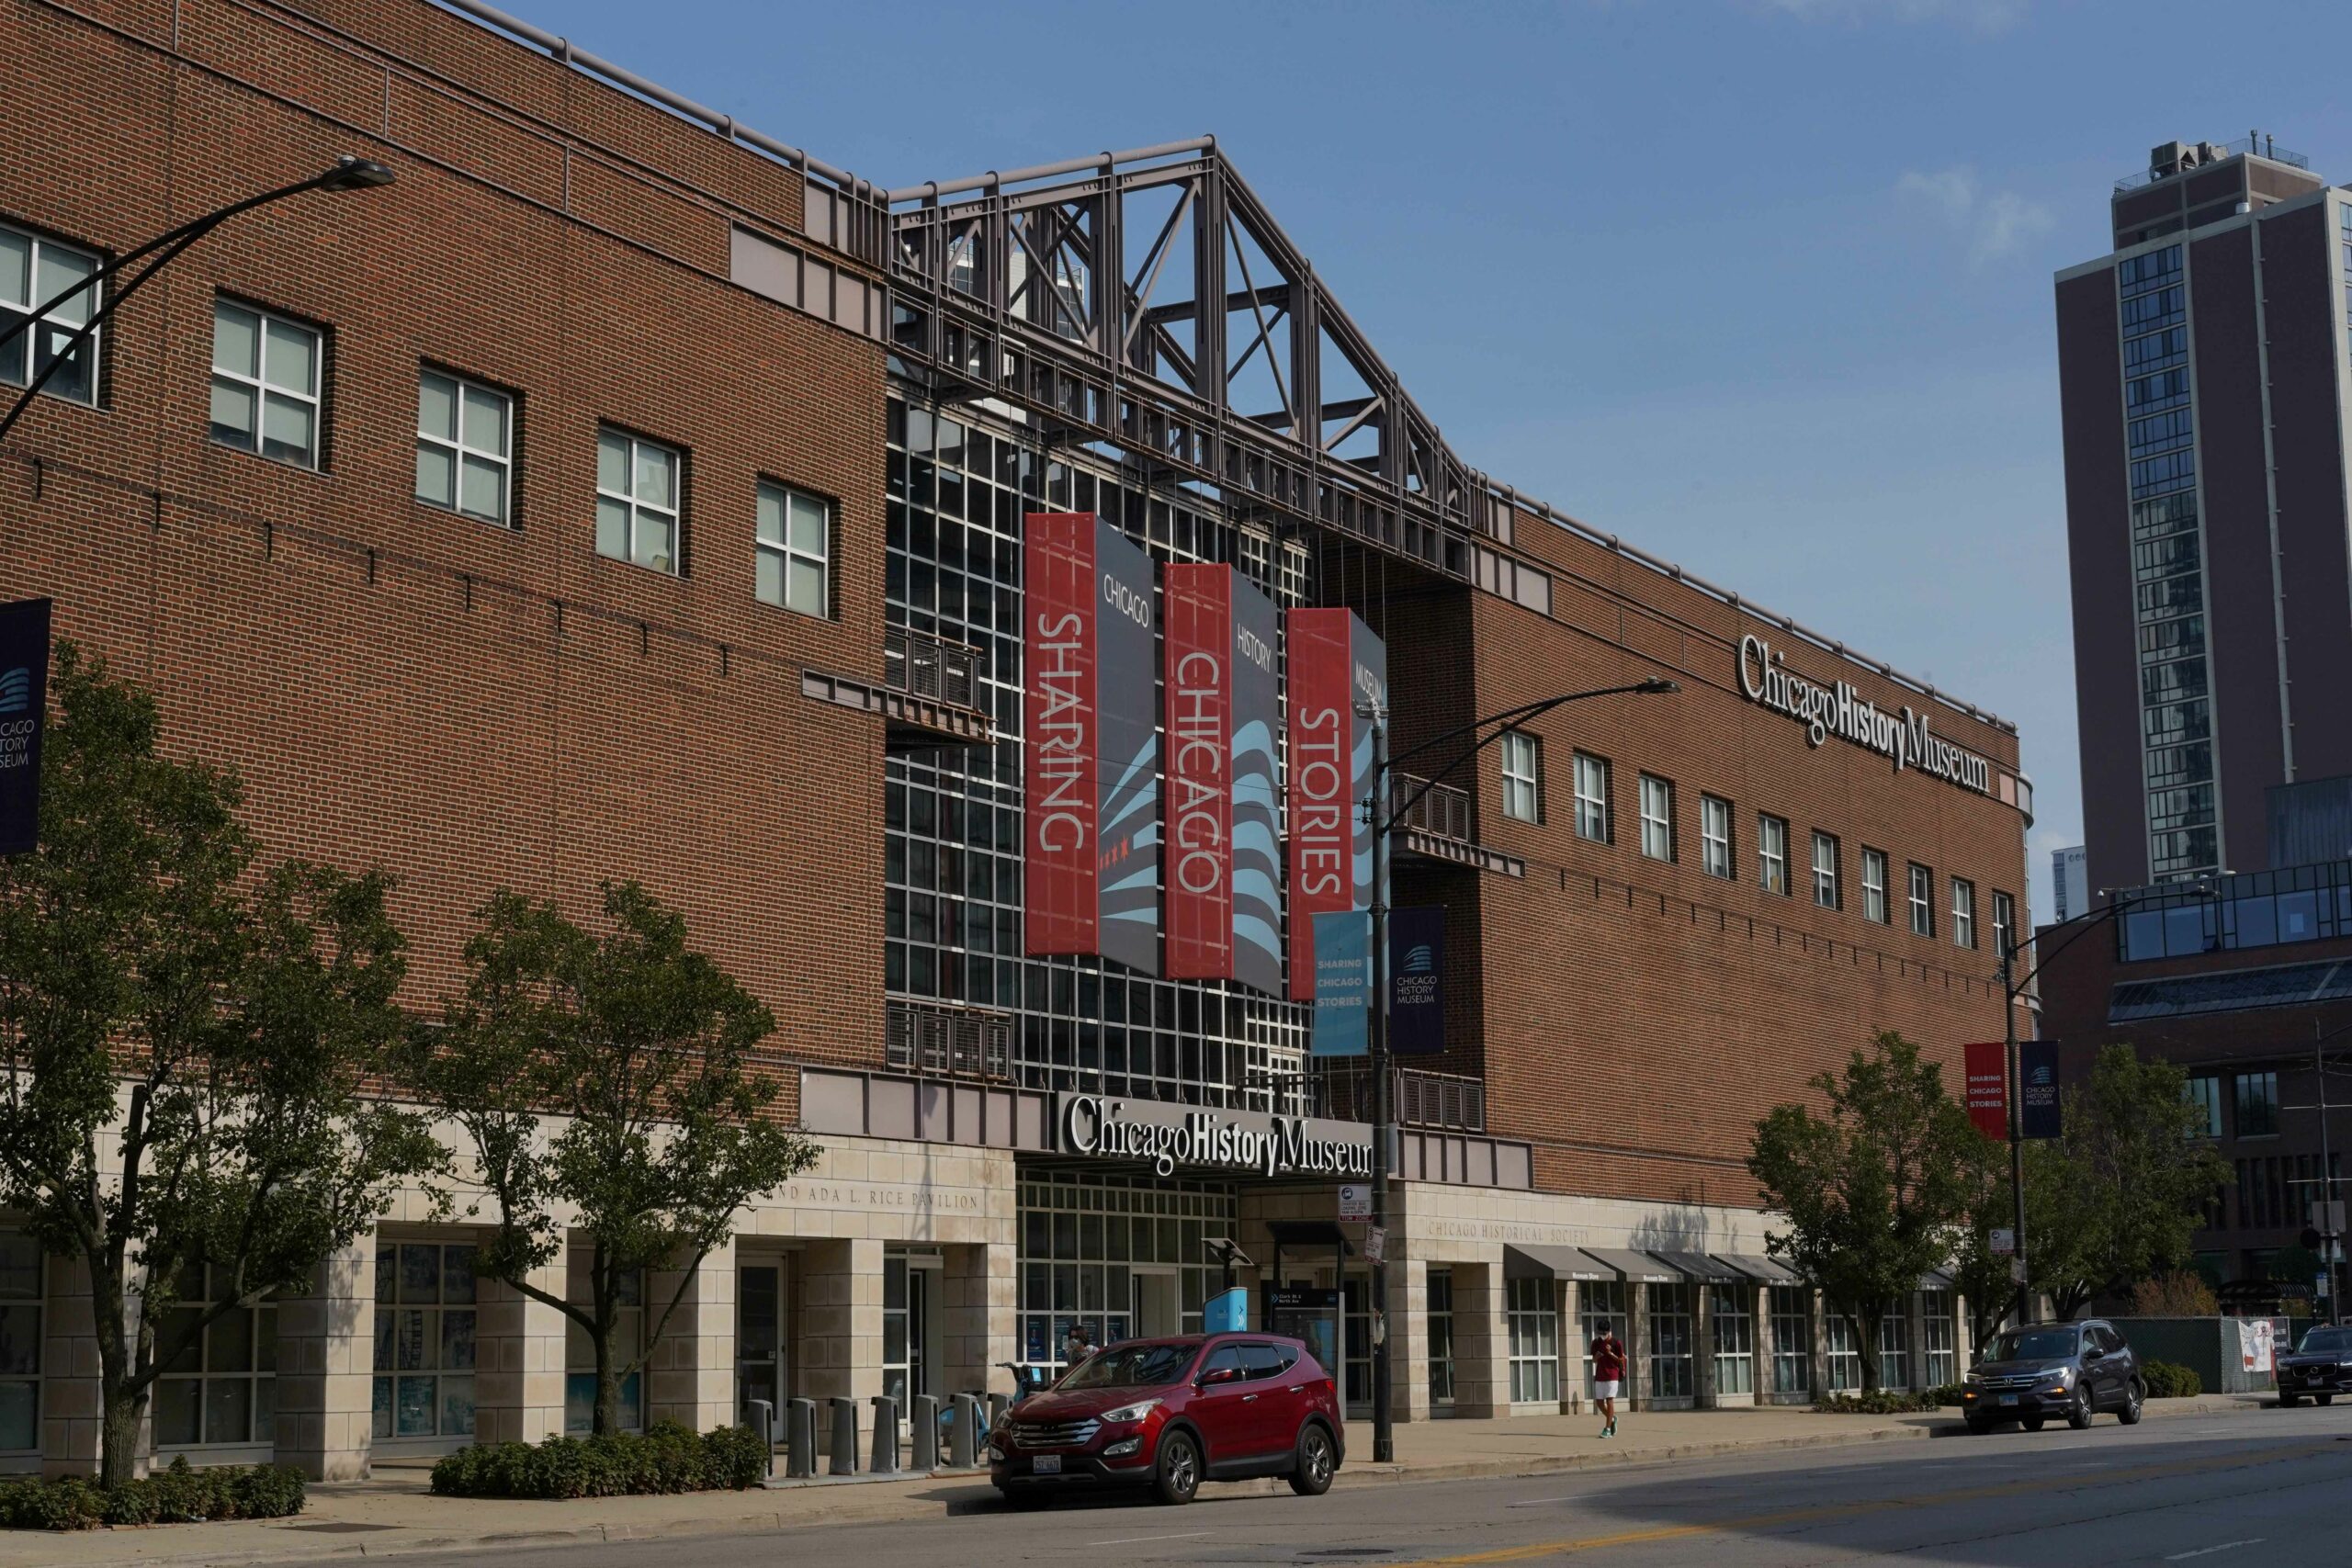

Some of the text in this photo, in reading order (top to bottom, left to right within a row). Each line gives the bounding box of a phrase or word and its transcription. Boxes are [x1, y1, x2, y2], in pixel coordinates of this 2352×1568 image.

[1103, 574, 1150, 629] CHICAGO
[1237, 622, 1272, 674] HISTORY
[1355, 660, 1383, 702] MUSEUM
[1739, 634, 1991, 794] Chicago History Museum
[1037, 613, 1084, 852] SHARING
[1177, 651, 1221, 895] CHICAGO
[1300, 707, 1341, 897] STORIES
[1317, 959, 1363, 970] SHARING
[1317, 977, 1363, 988] CHICAGO
[1396, 976, 1438, 986] CHICAGO
[1396, 986, 1434, 995] HISTORY
[1317, 996, 1363, 1008] STORIES
[1396, 995, 1435, 1004] MUSEUM
[1969, 1075, 2001, 1083] SHARING
[1969, 1087, 2002, 1095] CHICAGO
[2026, 1086, 2055, 1094] CHICAGO
[1969, 1100, 2003, 1108] STORIES
[1070, 1095, 1192, 1177] Chicago
[1192, 1112, 1279, 1178] History
[808, 1187, 840, 1202] ADA
[850, 1190, 861, 1203] L.
[870, 1190, 904, 1205] RICE
[912, 1192, 978, 1209] PAVILION
[1428, 1221, 1589, 1244] CHICAGO HISTORICAL SOCIETY
[1572, 1271, 1600, 1280] Museum Store
[1643, 1274, 1668, 1283] Museum Store
